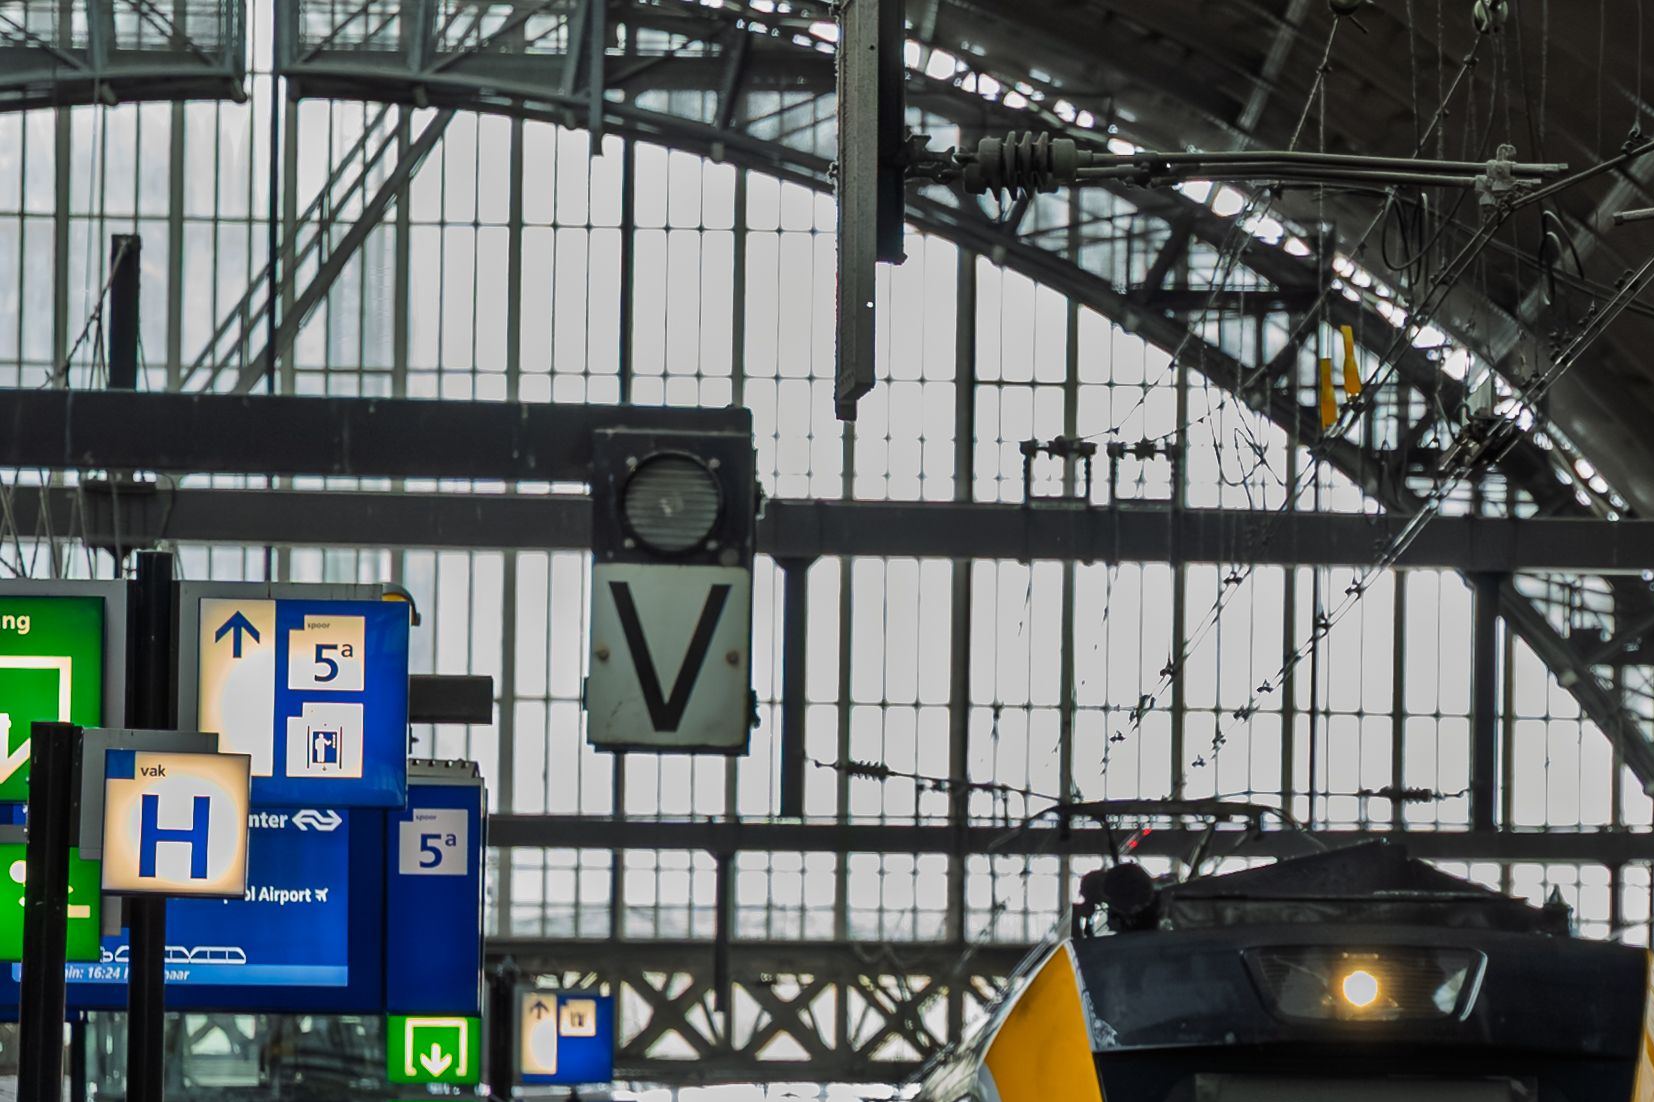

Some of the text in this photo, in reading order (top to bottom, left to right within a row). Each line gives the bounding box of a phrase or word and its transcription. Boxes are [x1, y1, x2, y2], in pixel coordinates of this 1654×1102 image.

[0, 614, 30, 635] ng
[608, 581, 732, 732] V
[141, 764, 166, 777] vak
[248, 812, 288, 828] nter
[138, 794, 210, 879] H
[258, 885, 312, 905] Airport
[87, 966, 120, 979] 16:24
